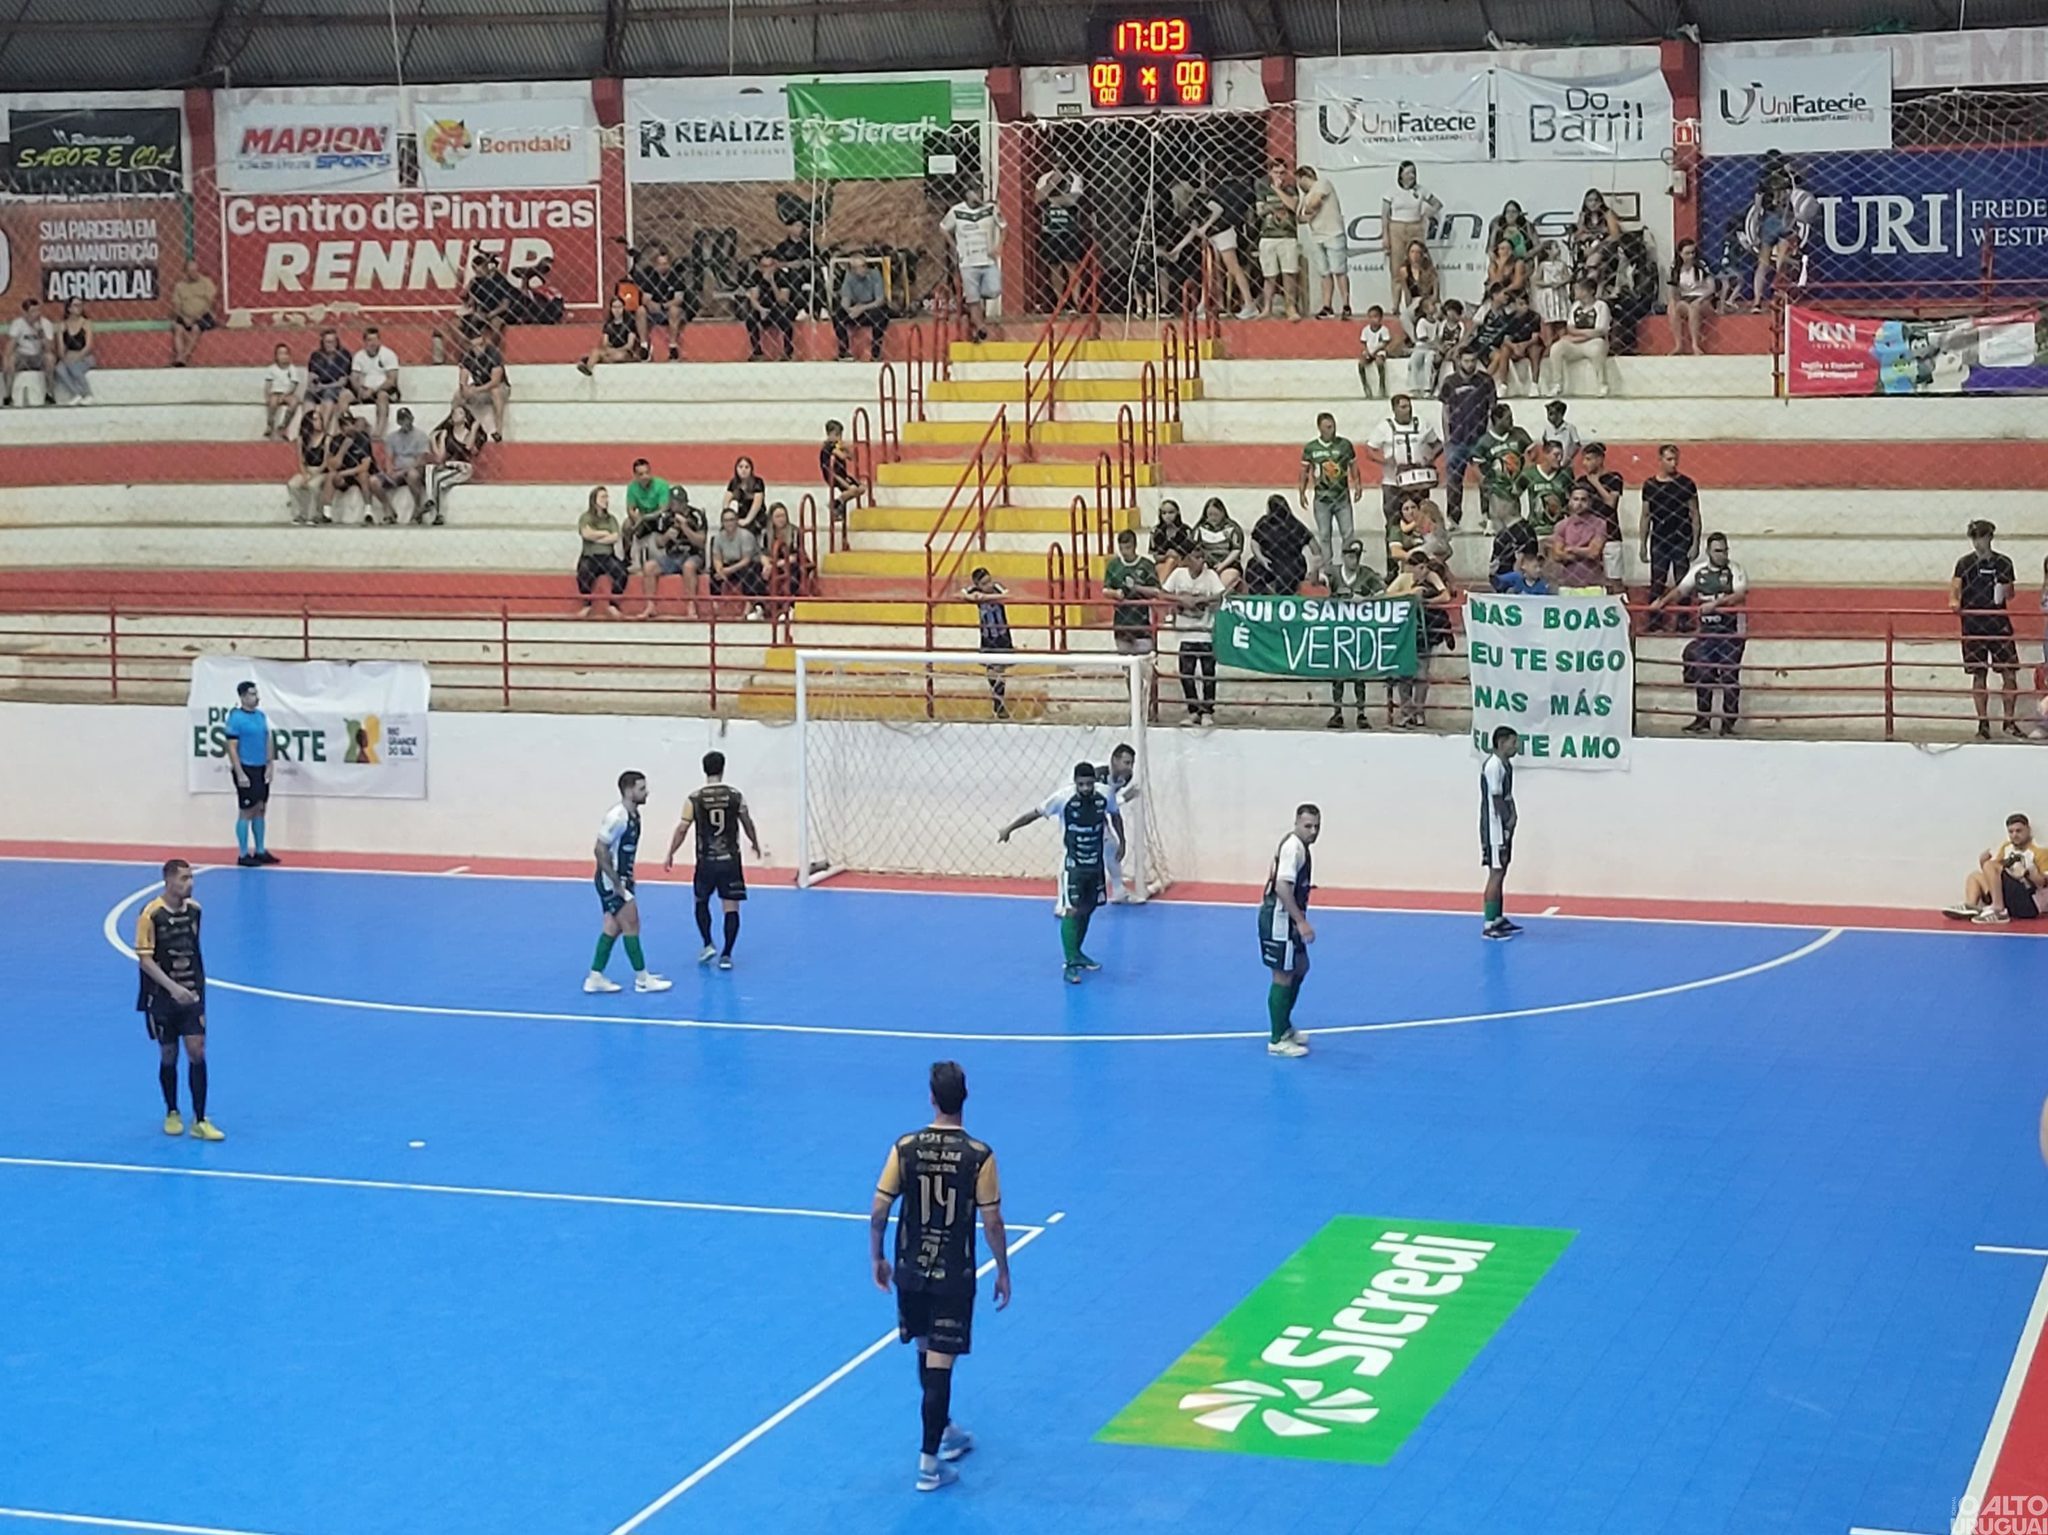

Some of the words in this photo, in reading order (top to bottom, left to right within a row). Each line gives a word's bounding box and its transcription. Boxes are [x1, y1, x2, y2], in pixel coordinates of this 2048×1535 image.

[1118, 20, 1186, 51] 17:03
[1093, 63, 1121, 88] 00
[1176, 61, 1205, 85] 00
[1100, 88, 1117, 102] 00
[1150, 87, 1156, 101] 1
[1182, 85, 1201, 101] 00
[1566, 87, 1609, 111] Do
[1760, 92, 1867, 115] UniFatecie
[675, 120, 785, 143] REALIZE
[840, 116, 937, 143] Sicredi
[1362, 112, 1477, 135] UniFatecie
[1530, 100, 1643, 142] Barril
[241, 126, 388, 154] MARION
[479, 134, 571, 154] Bomdaki
[17, 147, 101, 168] SABOR
[106, 146, 123, 167] E
[130, 146, 176, 168] CIA
[316, 154, 391, 169] SPORTS
[226, 197, 367, 235] Centro
[372, 196, 418, 231] de
[424, 194, 594, 230] Pinturas
[1971, 199, 2048, 219] FREDE
[40, 221, 67, 240] SUA
[69, 220, 133, 239] PARCEIRA
[135, 219, 156, 238] EM
[1817, 193, 1949, 255] URI
[40, 245, 74, 262] CADA
[75, 241, 158, 264] MANUTENÇÃO
[49, 265, 151, 300] AGRÍCOLA!
[1279, 600, 1297, 622] O
[1302, 600, 1411, 624] SANGUE
[1470, 600, 1522, 626] NAS
[1543, 606, 1621, 631] BOAS
[1233, 622, 1250, 649] É
[1282, 626, 1400, 672] VERDE
[1471, 641, 1503, 668] EU
[1511, 648, 1547, 671] TE
[1555, 650, 1626, 673] SIGO
[1474, 685, 1528, 713] NAS
[1550, 688, 1613, 717] MÁS
[194, 726, 327, 762] ESRTE
[1517, 734, 1550, 757] TE
[1560, 735, 1622, 759] AMO
[709, 808, 726, 836] 9
[917, 1175, 957, 1227] 14
[1261, 1231, 1497, 1377] Sicredi
